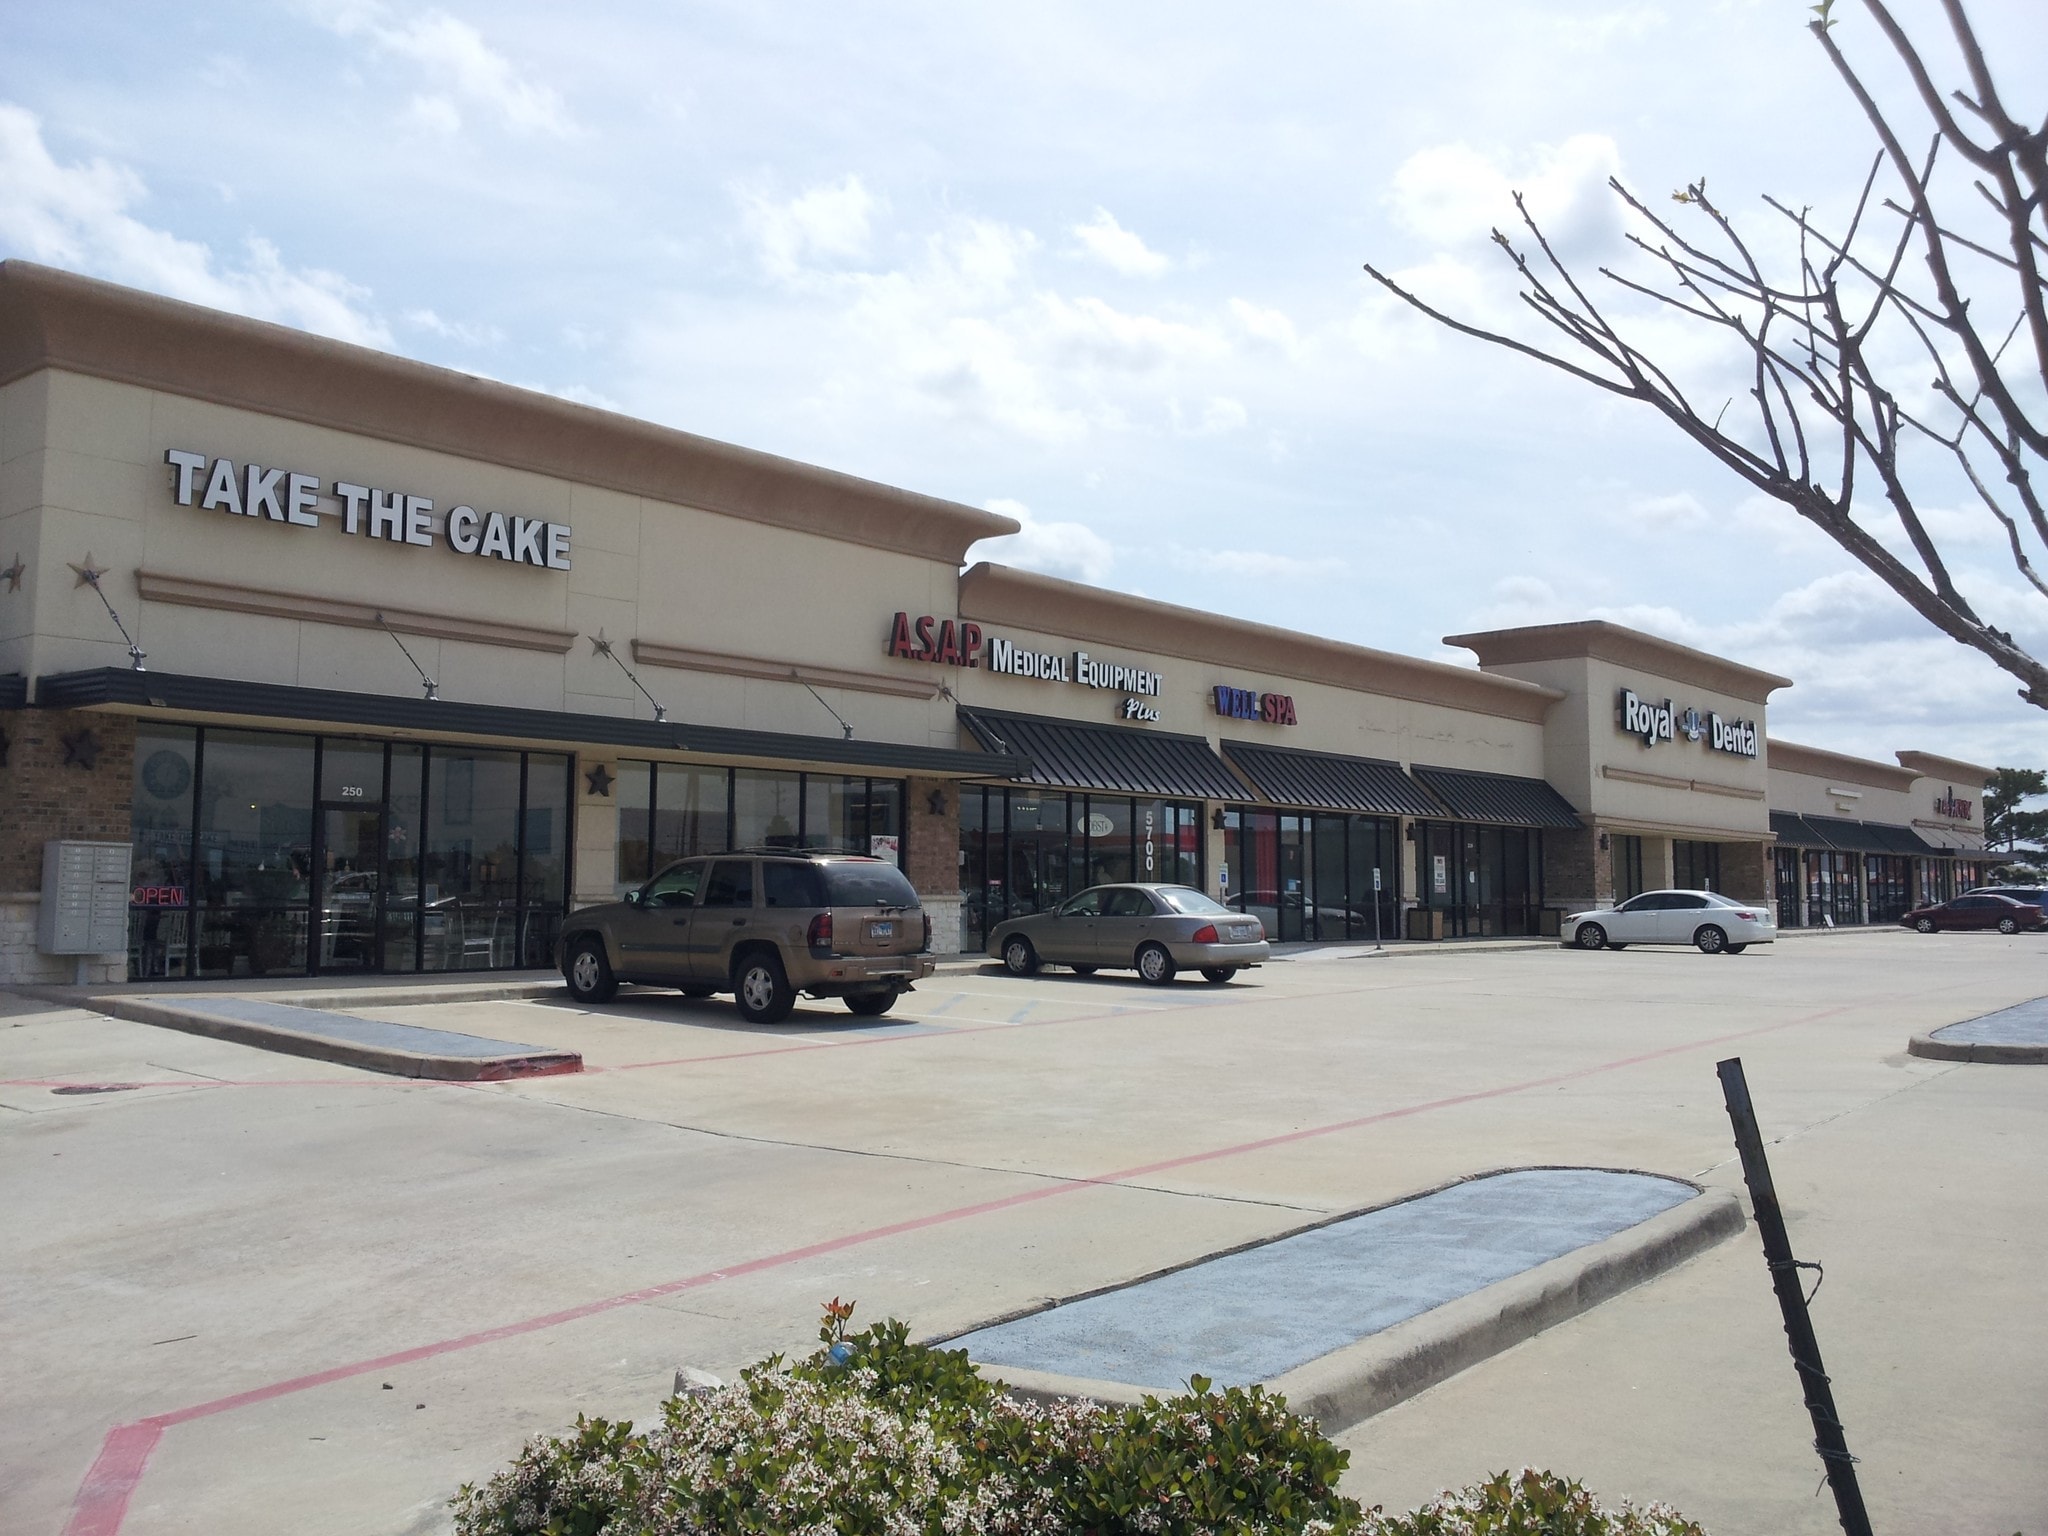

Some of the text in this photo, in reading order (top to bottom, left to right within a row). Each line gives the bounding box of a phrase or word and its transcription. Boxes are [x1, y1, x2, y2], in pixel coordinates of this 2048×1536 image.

[164, 449, 571, 571] TAKE THE CAKE
[988, 638, 1069, 682] MEDICAL
[1073, 651, 1163, 696] EQUIPMENT
[1124, 697, 1161, 721] Plus
[1213, 685, 1297, 725] WELL SPA
[1621, 688, 1758, 759] Royal Dental
[342, 786, 363, 797] 250
[1145, 810, 1154, 871] 5700
[133, 887, 184, 905] OPEN
